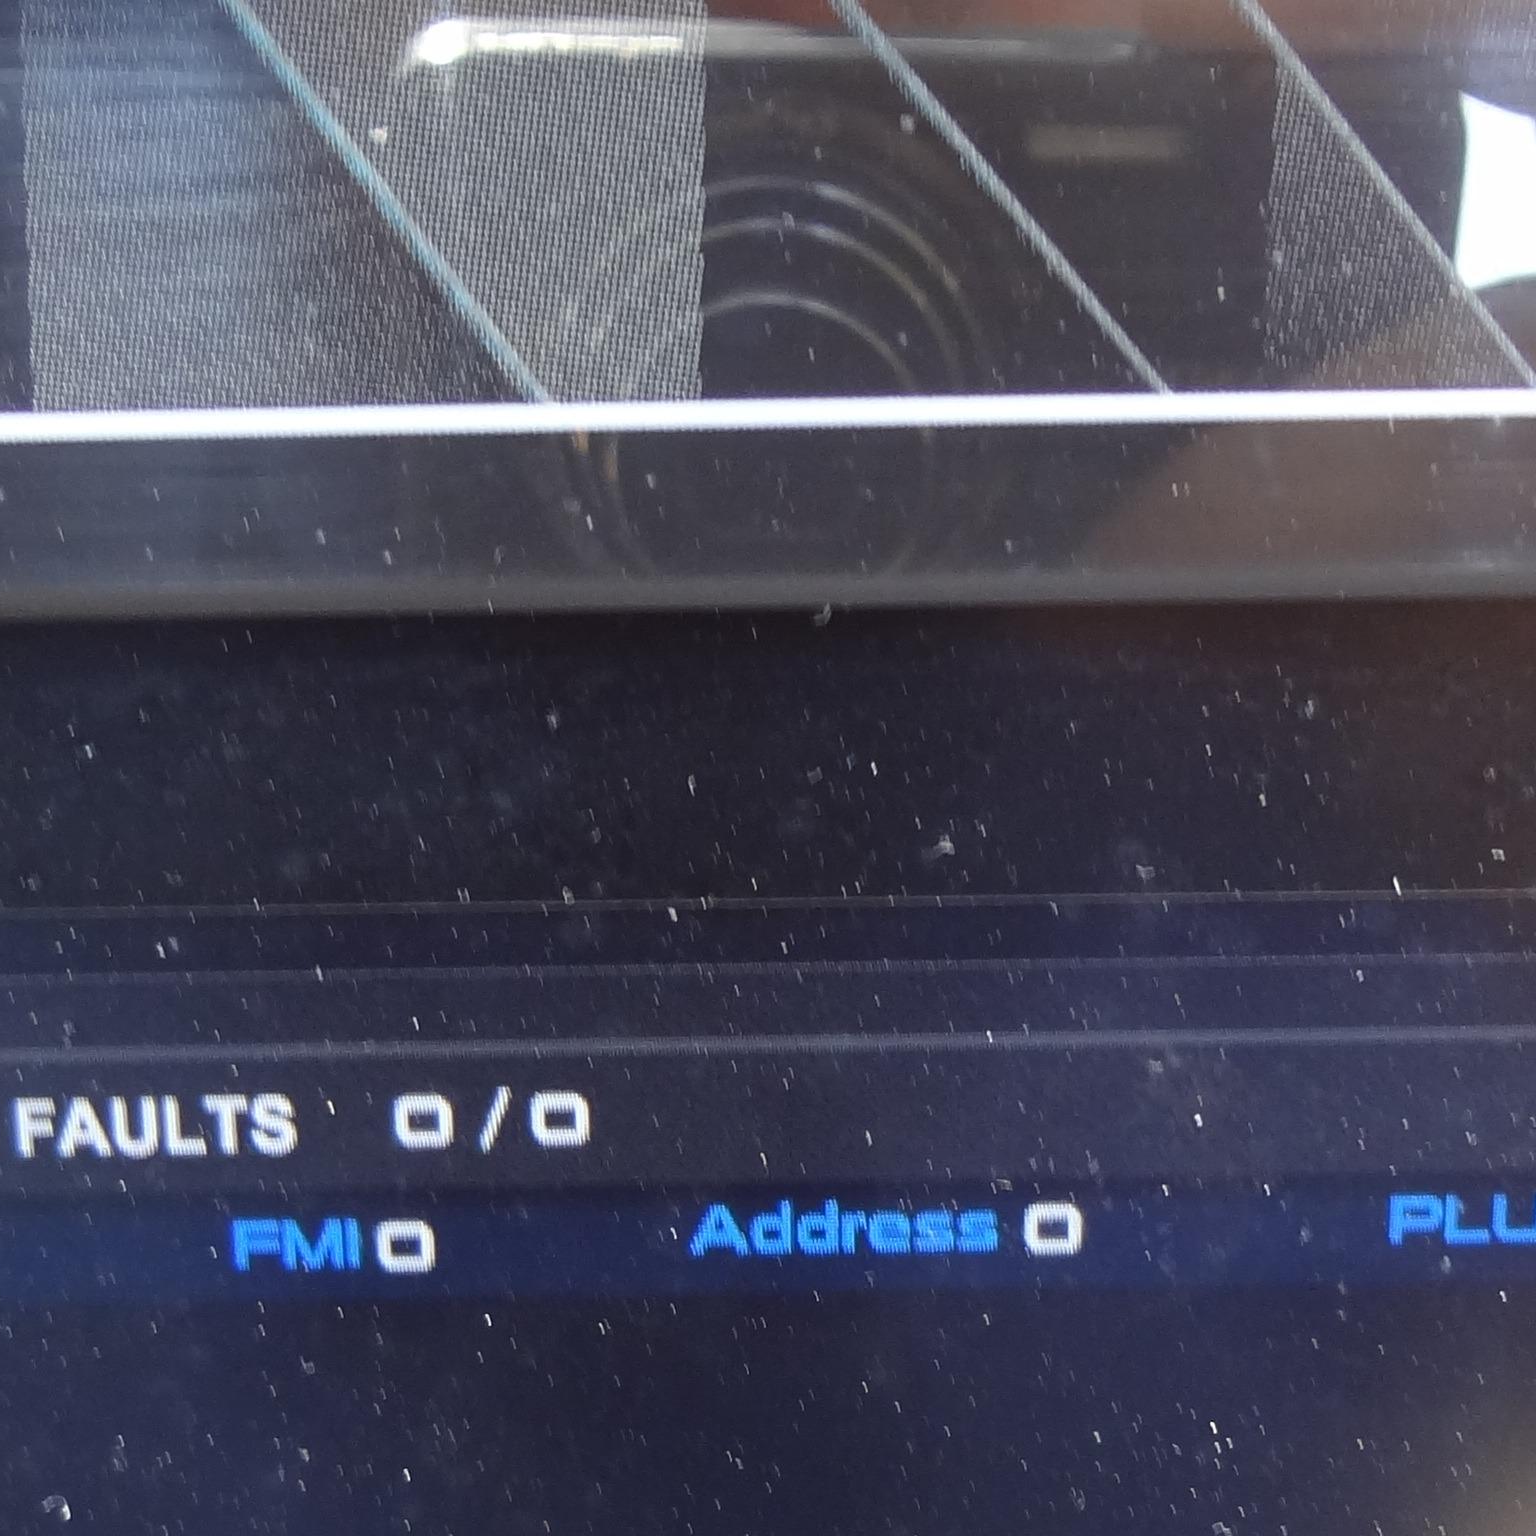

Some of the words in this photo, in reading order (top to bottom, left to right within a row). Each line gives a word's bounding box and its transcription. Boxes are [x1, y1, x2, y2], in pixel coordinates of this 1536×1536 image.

[12, 1093, 297, 1160] FAULTS
[231, 1217, 360, 1271] FMI
[690, 1200, 999, 1257] Address
